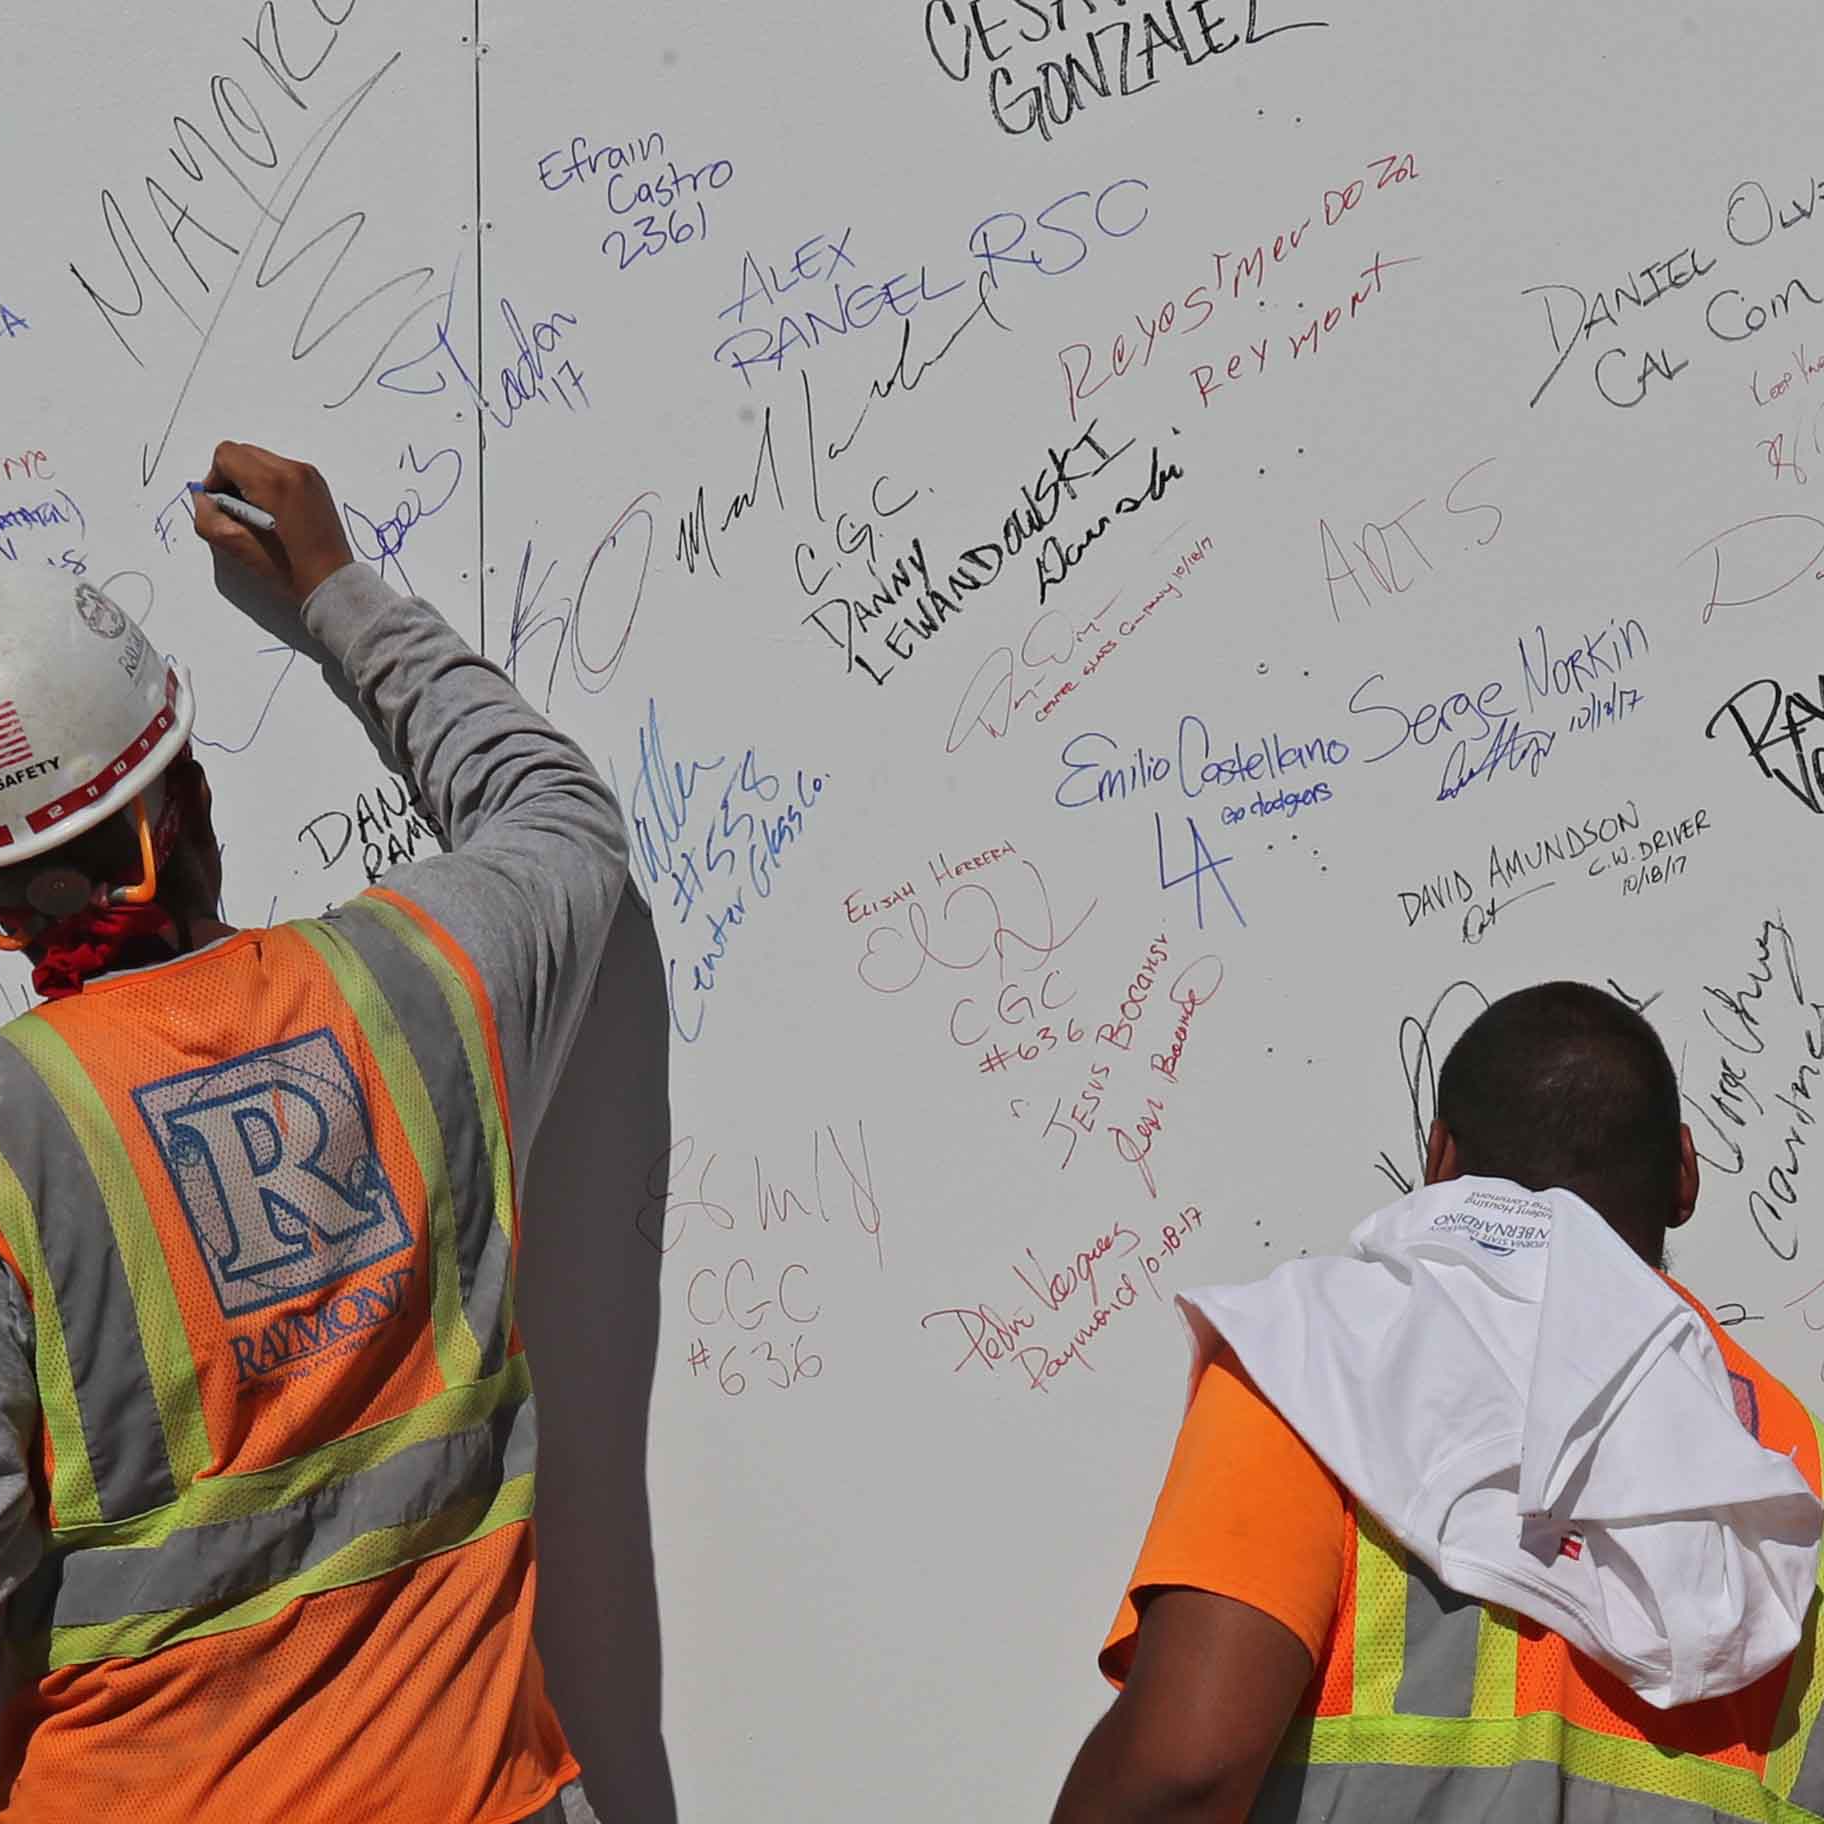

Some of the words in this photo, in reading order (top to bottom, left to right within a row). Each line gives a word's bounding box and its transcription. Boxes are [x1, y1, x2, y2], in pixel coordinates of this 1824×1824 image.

[538, 130, 665, 193] Efrain
[606, 159, 735, 215] Castro
[601, 208, 709, 271] 2361
[714, 265, 966, 390] RANGEL
[969, 179, 1149, 289] RSC
[718, 227, 856, 323] ALEX
[1521, 248, 1717, 408] DANIEL
[1594, 347, 1690, 408] CAL
[801, 538, 939, 673] DANNY
[1054, 731, 1172, 810] Emilio
[1176, 714, 1351, 800] Castellano
[1348, 673, 1518, 765] Serge
[47, 805, 66, 819] 12
[113, 759, 128, 776] 10
[1155, 810, 1247, 929] LA
[1397, 869, 1474, 930] DAVID
[1484, 801, 1640, 891] AMUNDSON
